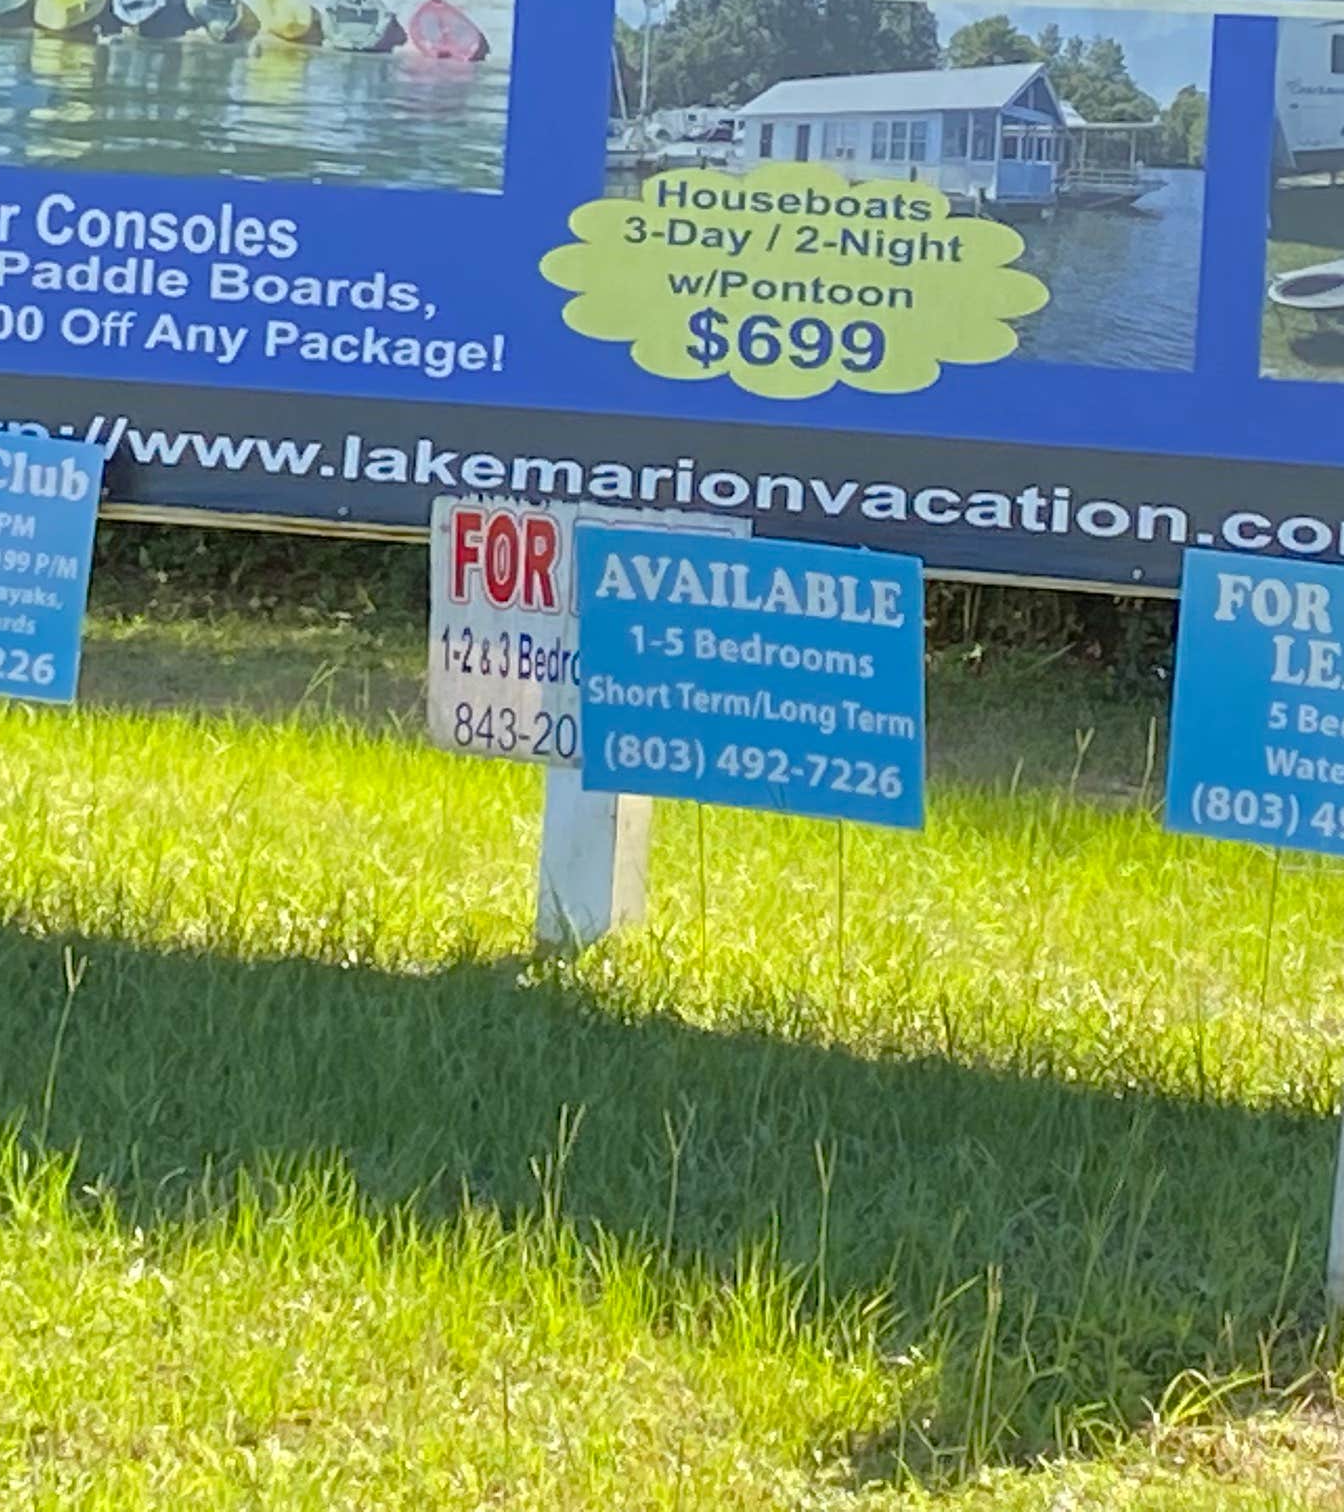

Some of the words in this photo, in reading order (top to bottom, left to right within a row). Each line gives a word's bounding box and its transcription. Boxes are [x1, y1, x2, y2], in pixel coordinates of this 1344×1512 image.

[36, 192, 300, 260] Consoles
[657, 178, 933, 222] Houseboats
[624, 216, 752, 254] 3-Day
[766, 223, 783, 252] /
[794, 226, 964, 268] 2-Night
[210, 261, 439, 322] Boards,
[667, 268, 915, 309] w/Pontoon
[61, 307, 138, 348] Off
[145, 313, 249, 364] Any
[265, 319, 506, 379] Package!
[686, 305, 887, 374] $699
[34, 555, 79, 581] P/M
[451, 508, 558, 609] FOR
[596, 552, 905, 629] AVAILABLE
[1213, 573, 1332, 635] FOR
[441, 624, 473, 674] 1-2
[481, 639, 491, 675] &
[499, 631, 511, 678] 3
[630, 624, 684, 658] 1-5
[694, 631, 875, 680] Bedrooms
[454, 701, 578, 760] 843-20
[588, 674, 671, 711] Short
[676, 682, 837, 736] Term/Long
[842, 700, 916, 740] Term
[1268, 701, 1288, 730] 5
[604, 731, 705, 780] (803)
[716, 744, 905, 800] 492-7226
[1191, 781, 1300, 838] (803)
